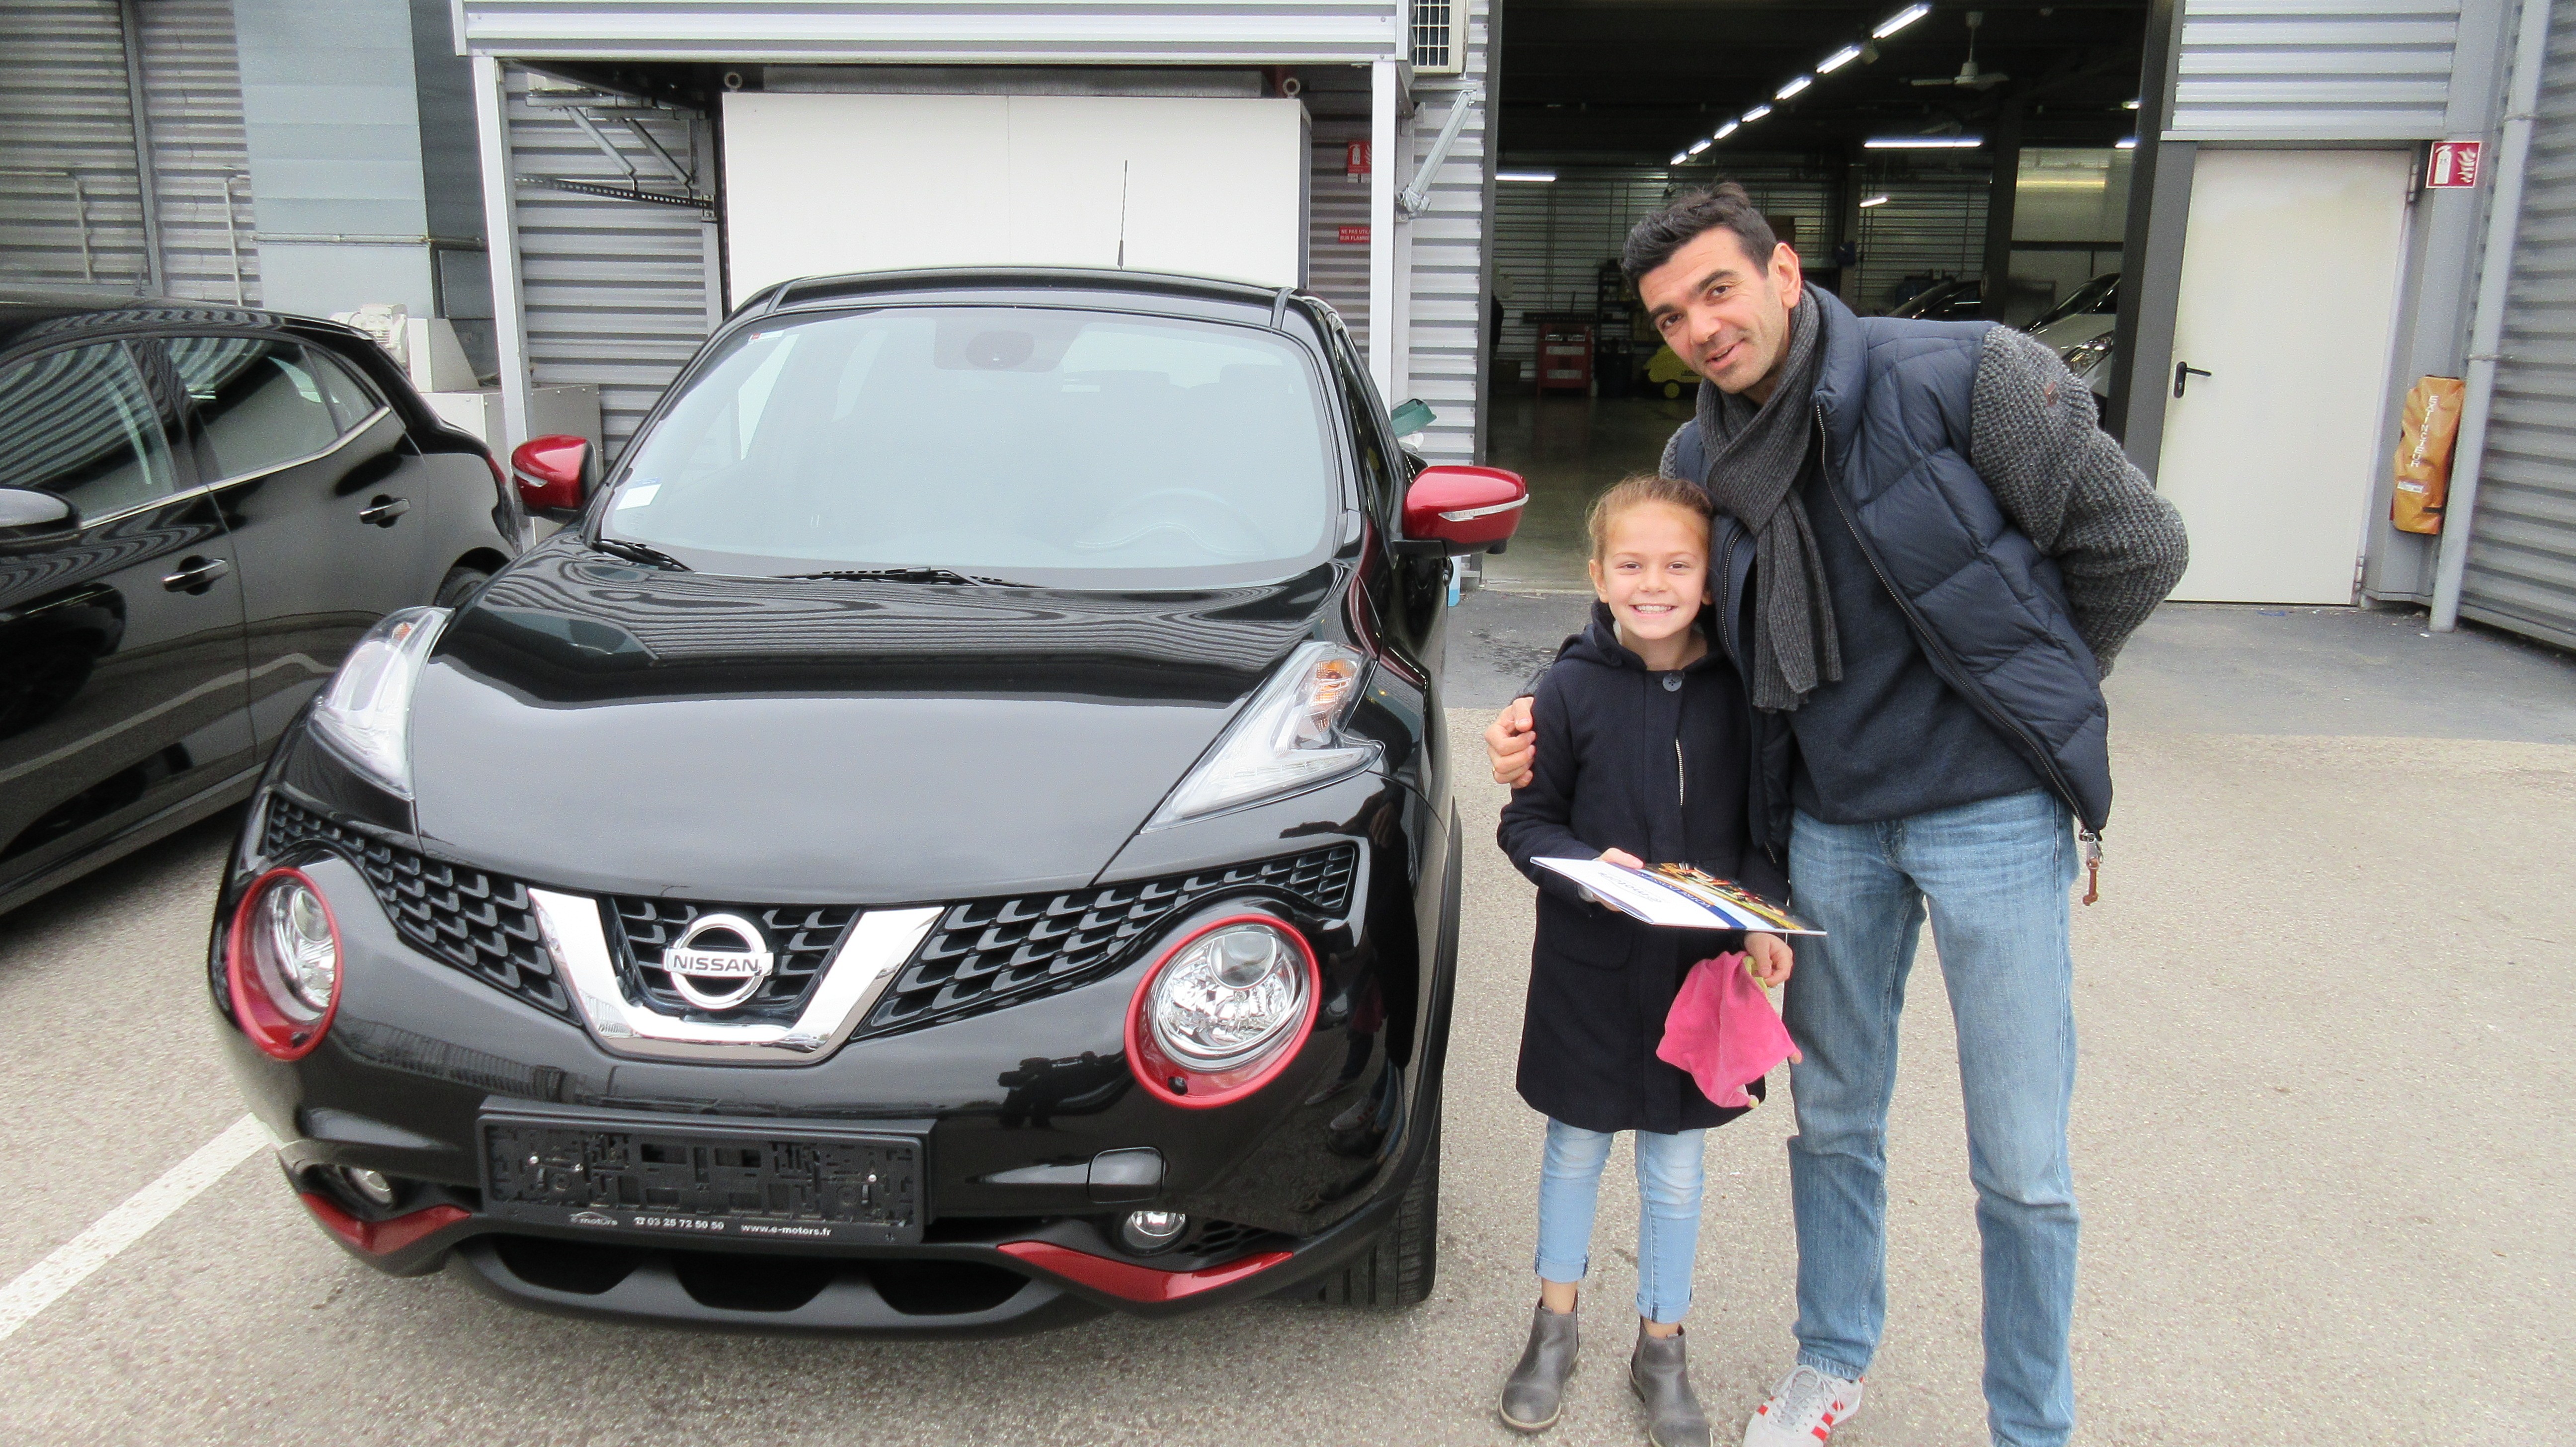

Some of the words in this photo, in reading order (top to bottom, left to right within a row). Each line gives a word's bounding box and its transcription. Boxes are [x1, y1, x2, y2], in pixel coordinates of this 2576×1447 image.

[2411, 395, 2439, 468] EXTINCTEUR
[673, 955, 759, 972] NISSAN
[647, 1217, 660, 1226] 03
[663, 1218, 677, 1227] 25
[679, 1219, 693, 1228] 72
[741, 1224, 832, 1236] www.e-motors.fr
